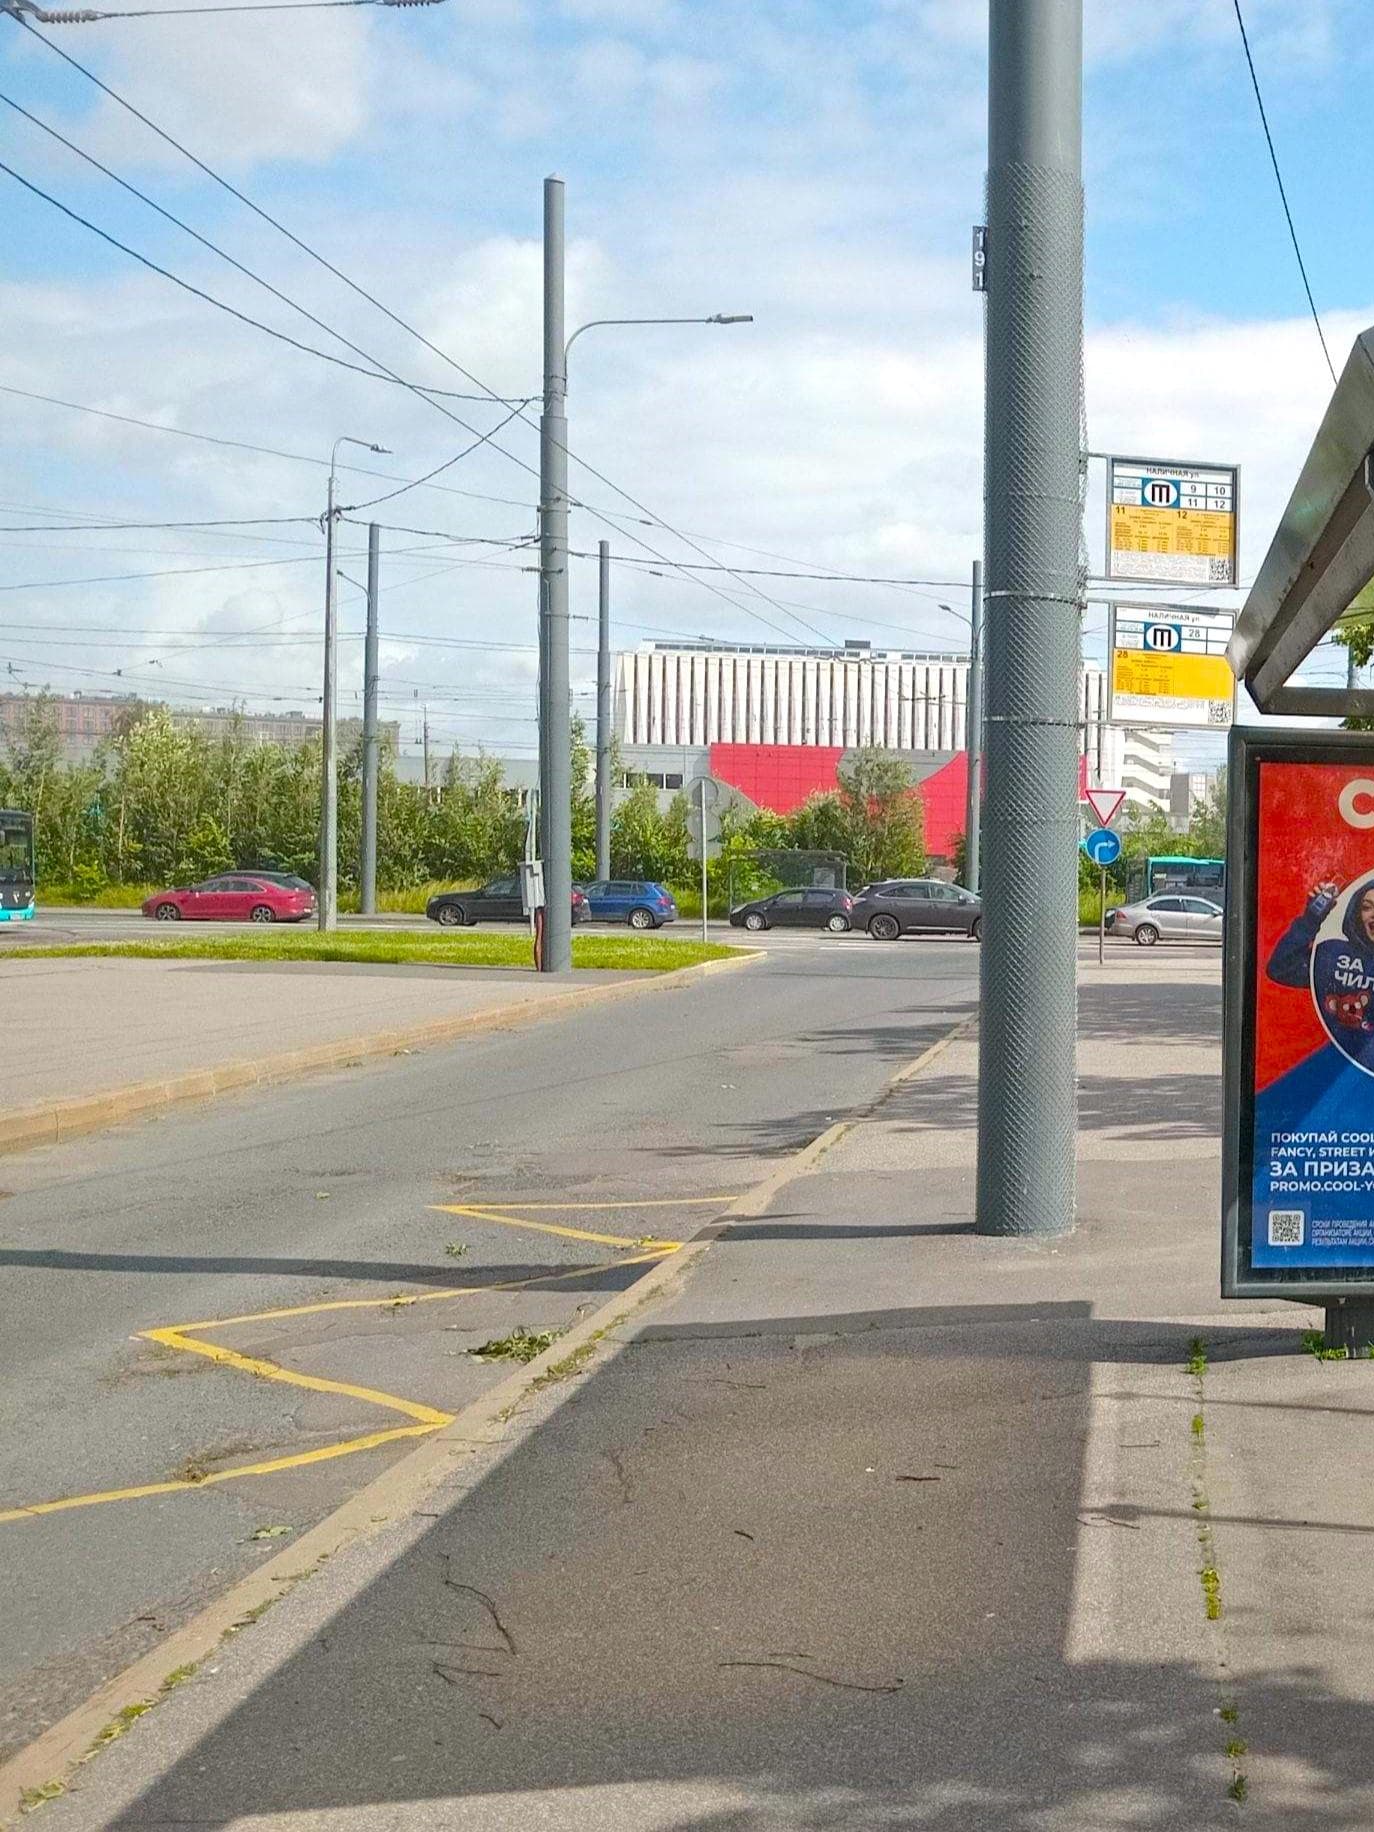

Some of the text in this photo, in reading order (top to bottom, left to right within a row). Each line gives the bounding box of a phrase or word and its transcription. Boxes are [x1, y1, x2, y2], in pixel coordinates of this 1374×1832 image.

[974, 230, 986, 287] 191
[1190, 485, 1197, 493] 9
[1214, 487, 1226, 495] 10
[1188, 498, 1198, 507] 11
[1214, 500, 1225, 509] 12
[1116, 506, 1126, 514] 11
[1177, 511, 1188, 520] 12
[1188, 628, 1200, 638] 28
[1116, 650, 1128, 659] 28
[1336, 954, 1364, 973] ЗА
[1271, 1130, 1338, 1143] ПОКУПАЙ
[1271, 1147, 1316, 1158] FANCY,
[1318, 1147, 1366, 1157] STREET
[1270, 1161, 1298, 1177] ЗА
